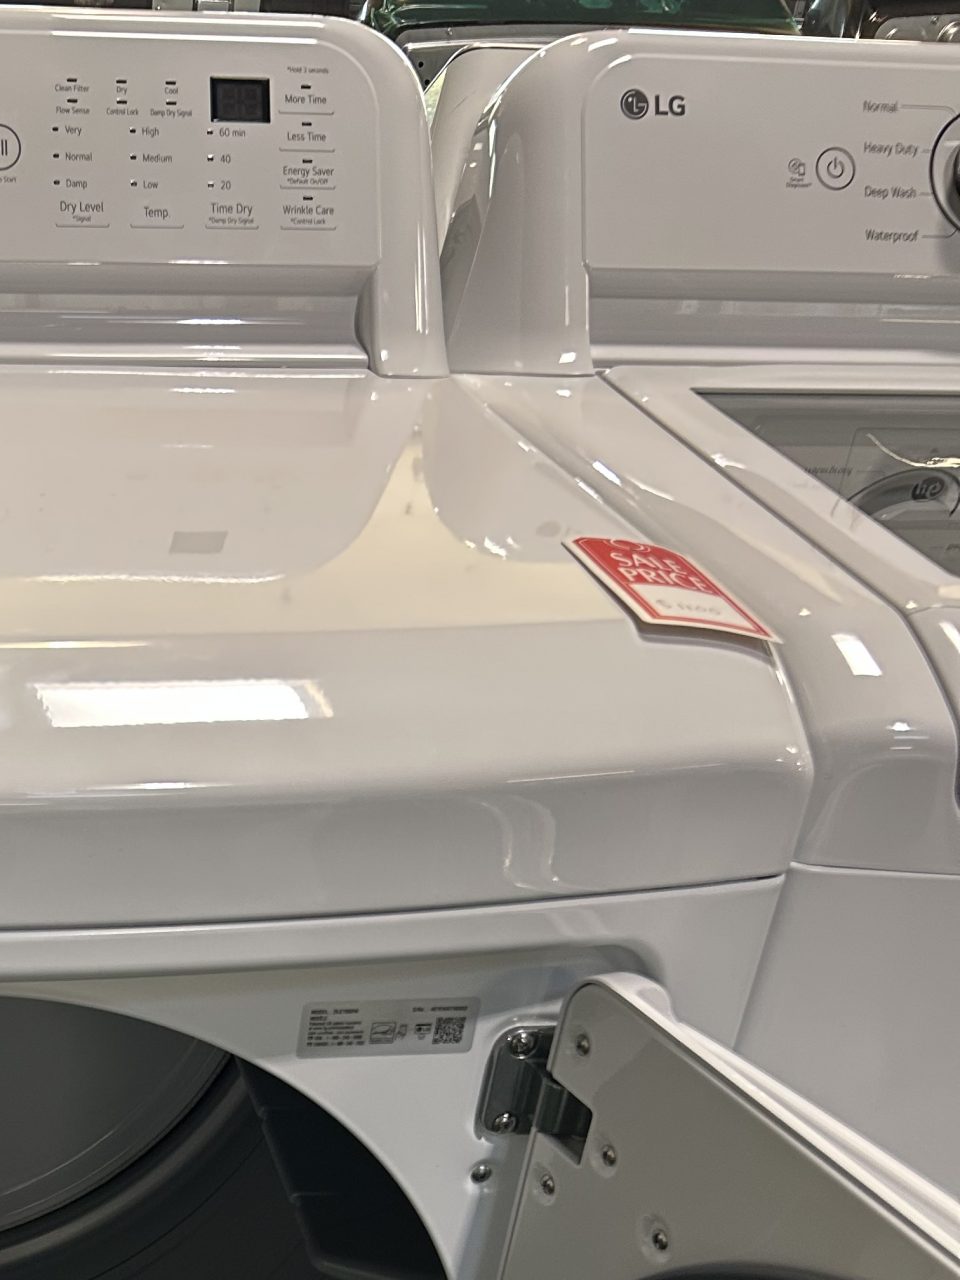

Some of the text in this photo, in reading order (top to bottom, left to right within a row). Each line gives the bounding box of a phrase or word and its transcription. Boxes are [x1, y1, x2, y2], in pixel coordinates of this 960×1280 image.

[55, 84, 90, 93] Clean Filter
[116, 86, 127, 95] Dry
[285, 94, 327, 104] More Time
[72, 107, 90, 115] Sense
[654, 95, 686, 117] LG
[863, 100, 898, 113] Normal
[65, 125, 82, 136] Very
[141, 127, 159, 138] High
[219, 128, 246, 137] 60 min
[287, 131, 327, 142] Less Time
[863, 142, 919, 157] Heavy Duty
[65, 152, 92, 161] Normal
[142, 154, 173, 163] Medium
[220, 154, 231, 164] 40
[283, 166, 335, 178] Energy Saver
[66, 178, 88, 189] Damp
[143, 181, 159, 189] Low
[220, 180, 231, 190] 20
[864, 185, 917, 200] Deep Wash
[59, 200, 104, 214] Dry Level
[211, 202, 253, 217] Time Dry
[282, 205, 335, 216] Wrinkle Care
[865, 229, 919, 243] Waterproof
[610, 552, 683, 573] SALE
[617, 567, 711, 592] PRICE
